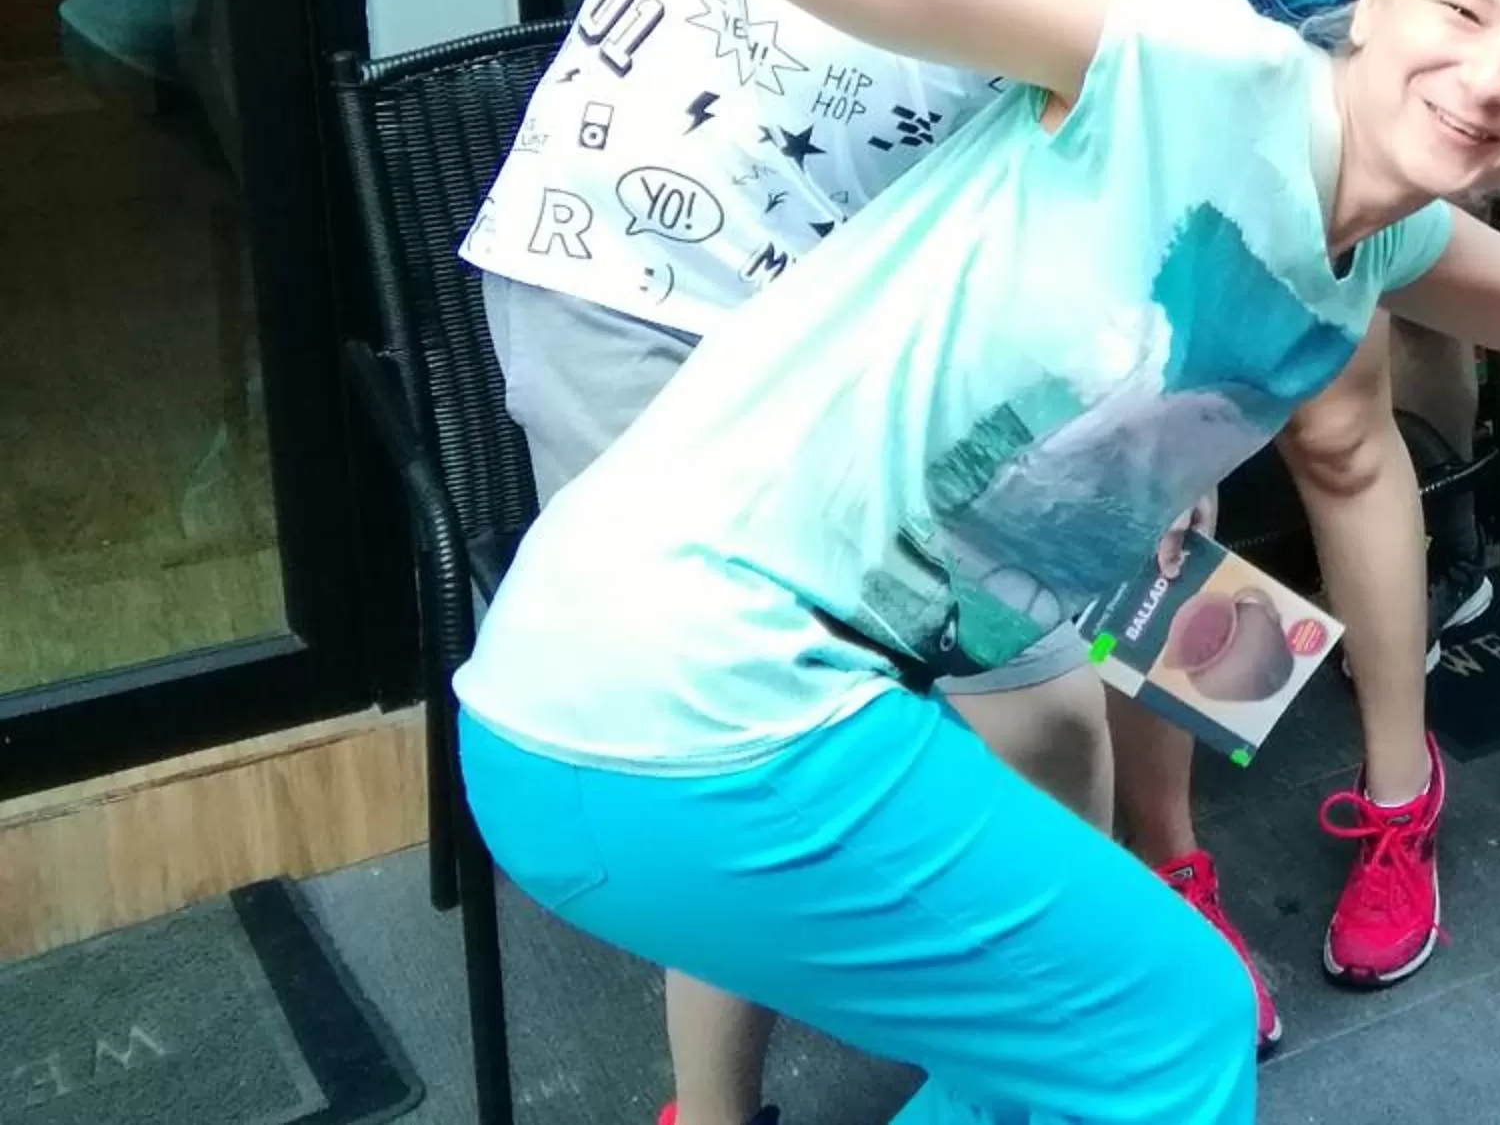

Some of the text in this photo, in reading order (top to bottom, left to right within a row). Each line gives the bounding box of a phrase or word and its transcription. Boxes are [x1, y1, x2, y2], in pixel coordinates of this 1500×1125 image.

[811, 90, 867, 125] HOP
[527, 186, 594, 260] R
[640, 175, 697, 231] YO!
